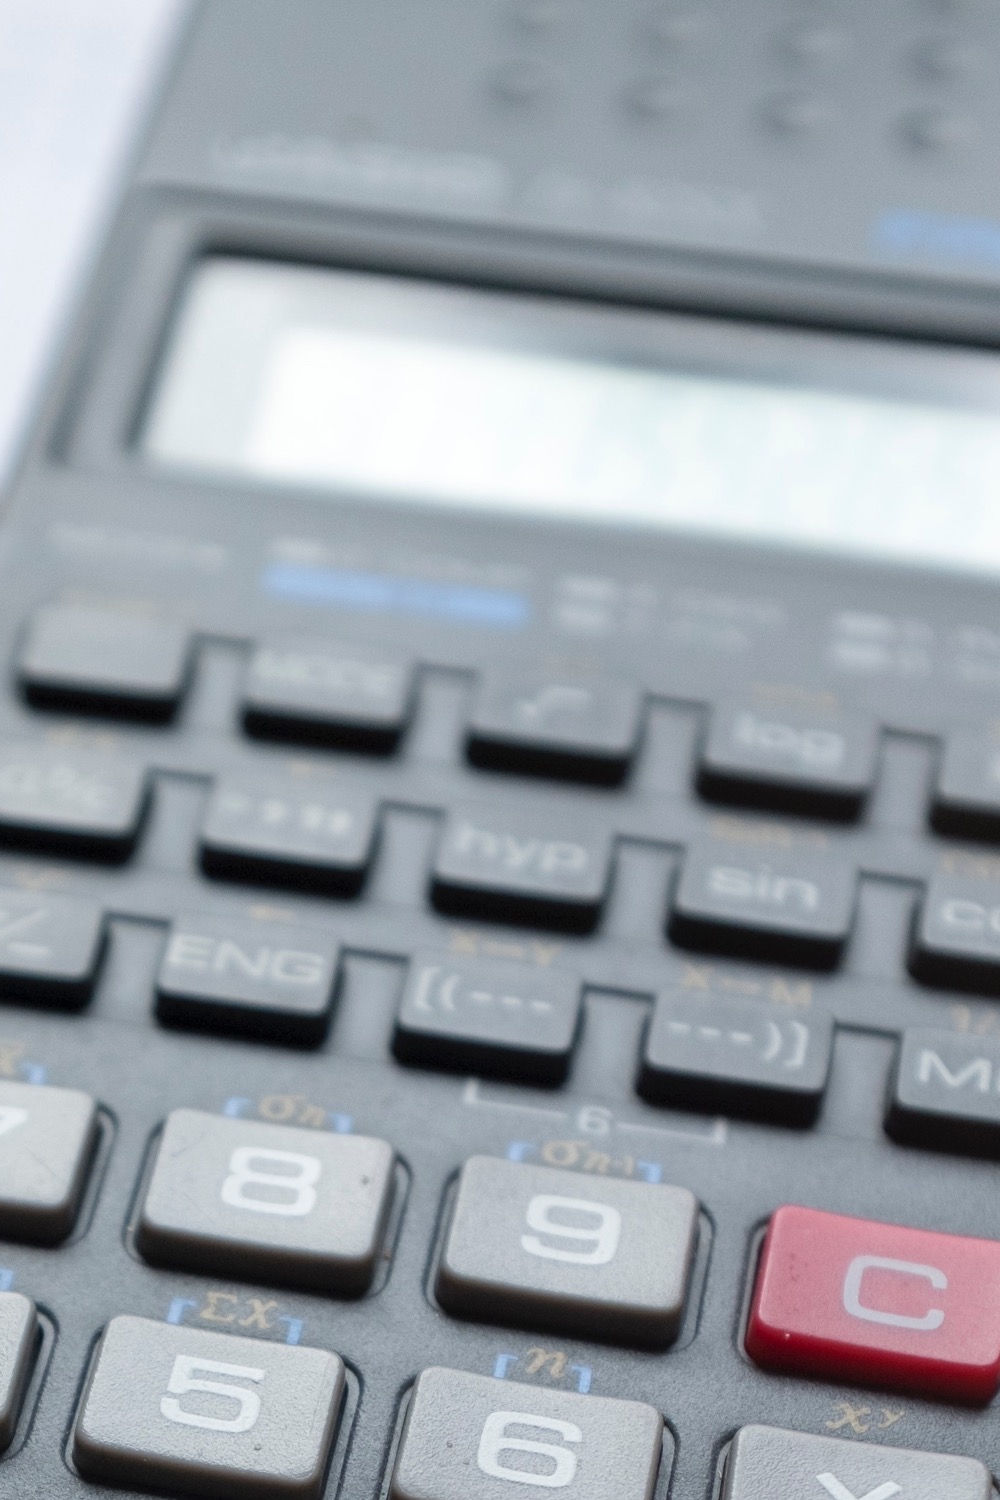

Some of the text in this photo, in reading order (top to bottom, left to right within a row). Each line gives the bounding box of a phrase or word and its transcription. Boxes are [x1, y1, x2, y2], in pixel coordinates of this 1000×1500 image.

[734, 713, 844, 766] log
[456, 822, 588, 873] hyp
[709, 863, 819, 911] sin
[168, 932, 324, 986] ENG
[577, 1105, 613, 1137] 6
[220, 1145, 322, 1217] 8
[521, 1193, 623, 1266] 9
[843, 1253, 949, 1332] C
[160, 1354, 266, 1435] 5
[476, 1410, 584, 1489] 6
